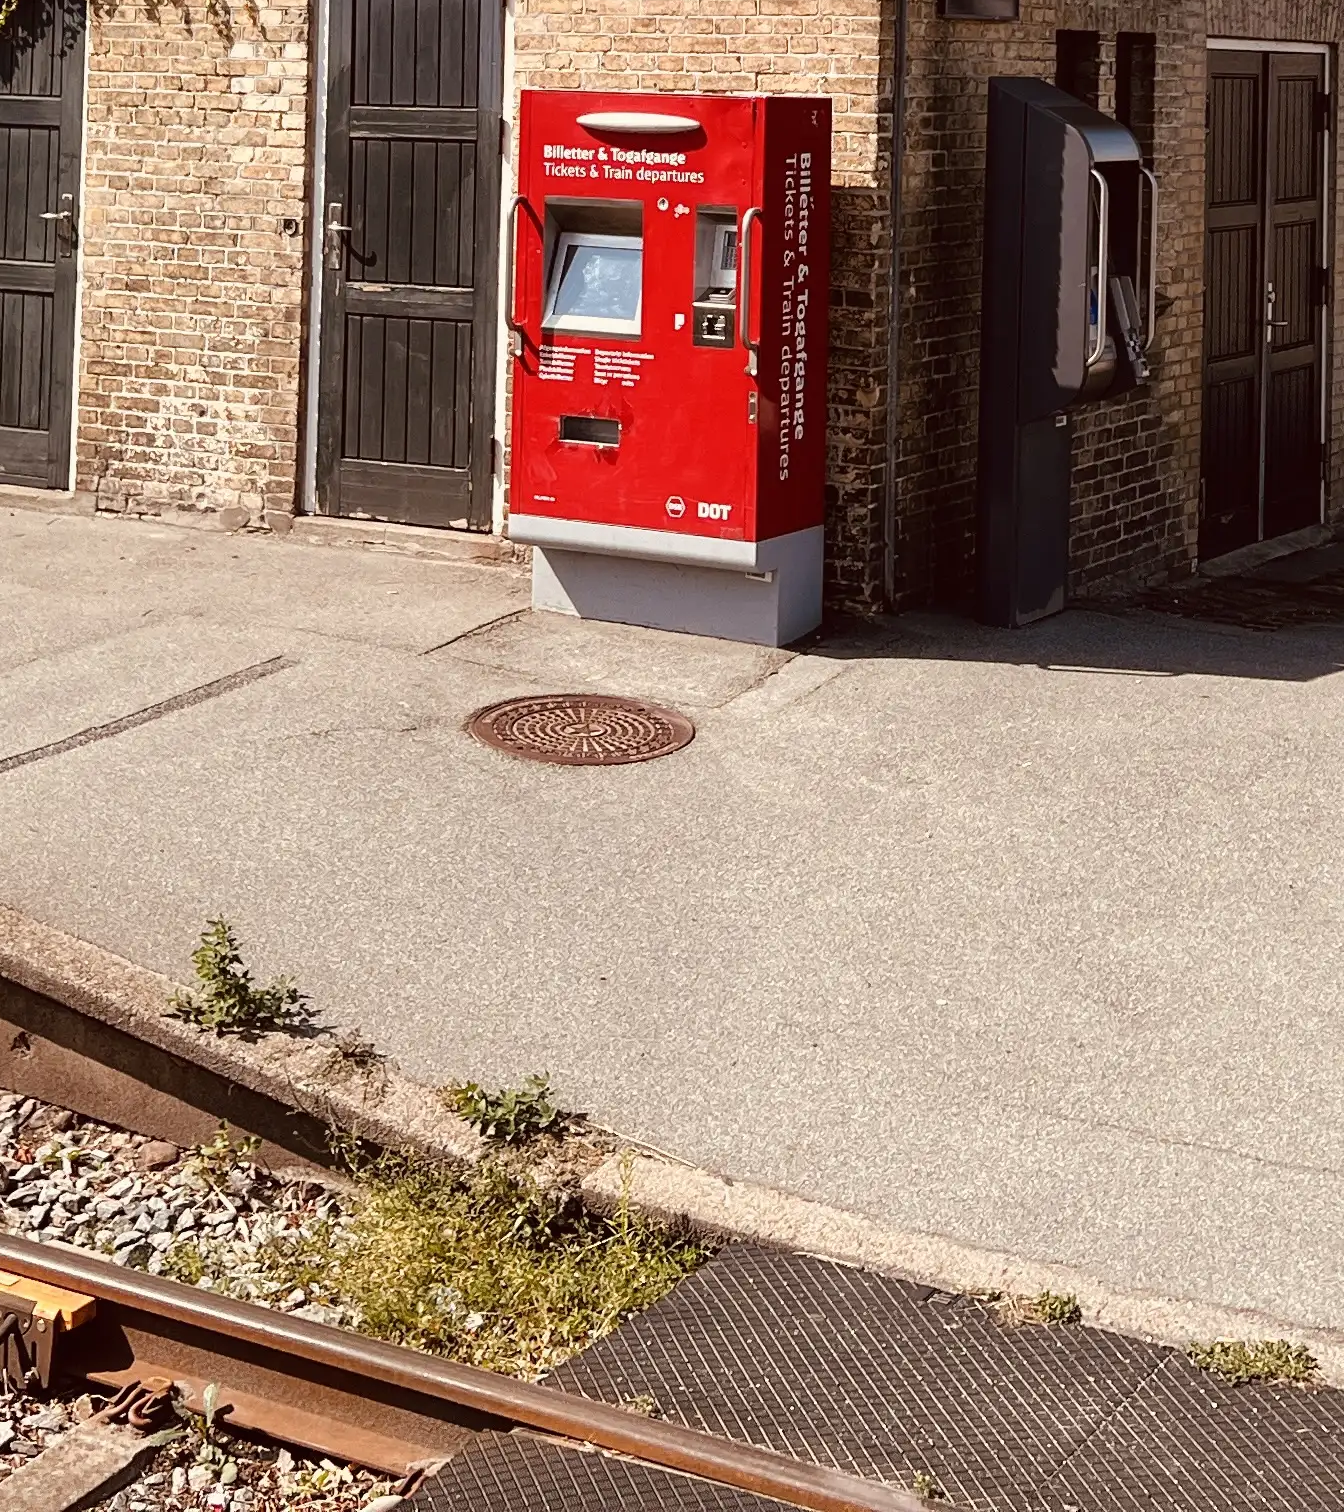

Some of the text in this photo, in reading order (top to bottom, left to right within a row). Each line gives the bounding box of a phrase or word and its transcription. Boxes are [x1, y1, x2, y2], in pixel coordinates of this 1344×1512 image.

[543, 144, 686, 167] Billetter & Togafgange
[543, 161, 705, 184] Tickets & Train departures
[793, 152, 812, 440] Billetter & Togafgange
[779, 152, 797, 481] Tickets & Train departures
[697, 501, 733, 521] DOT
